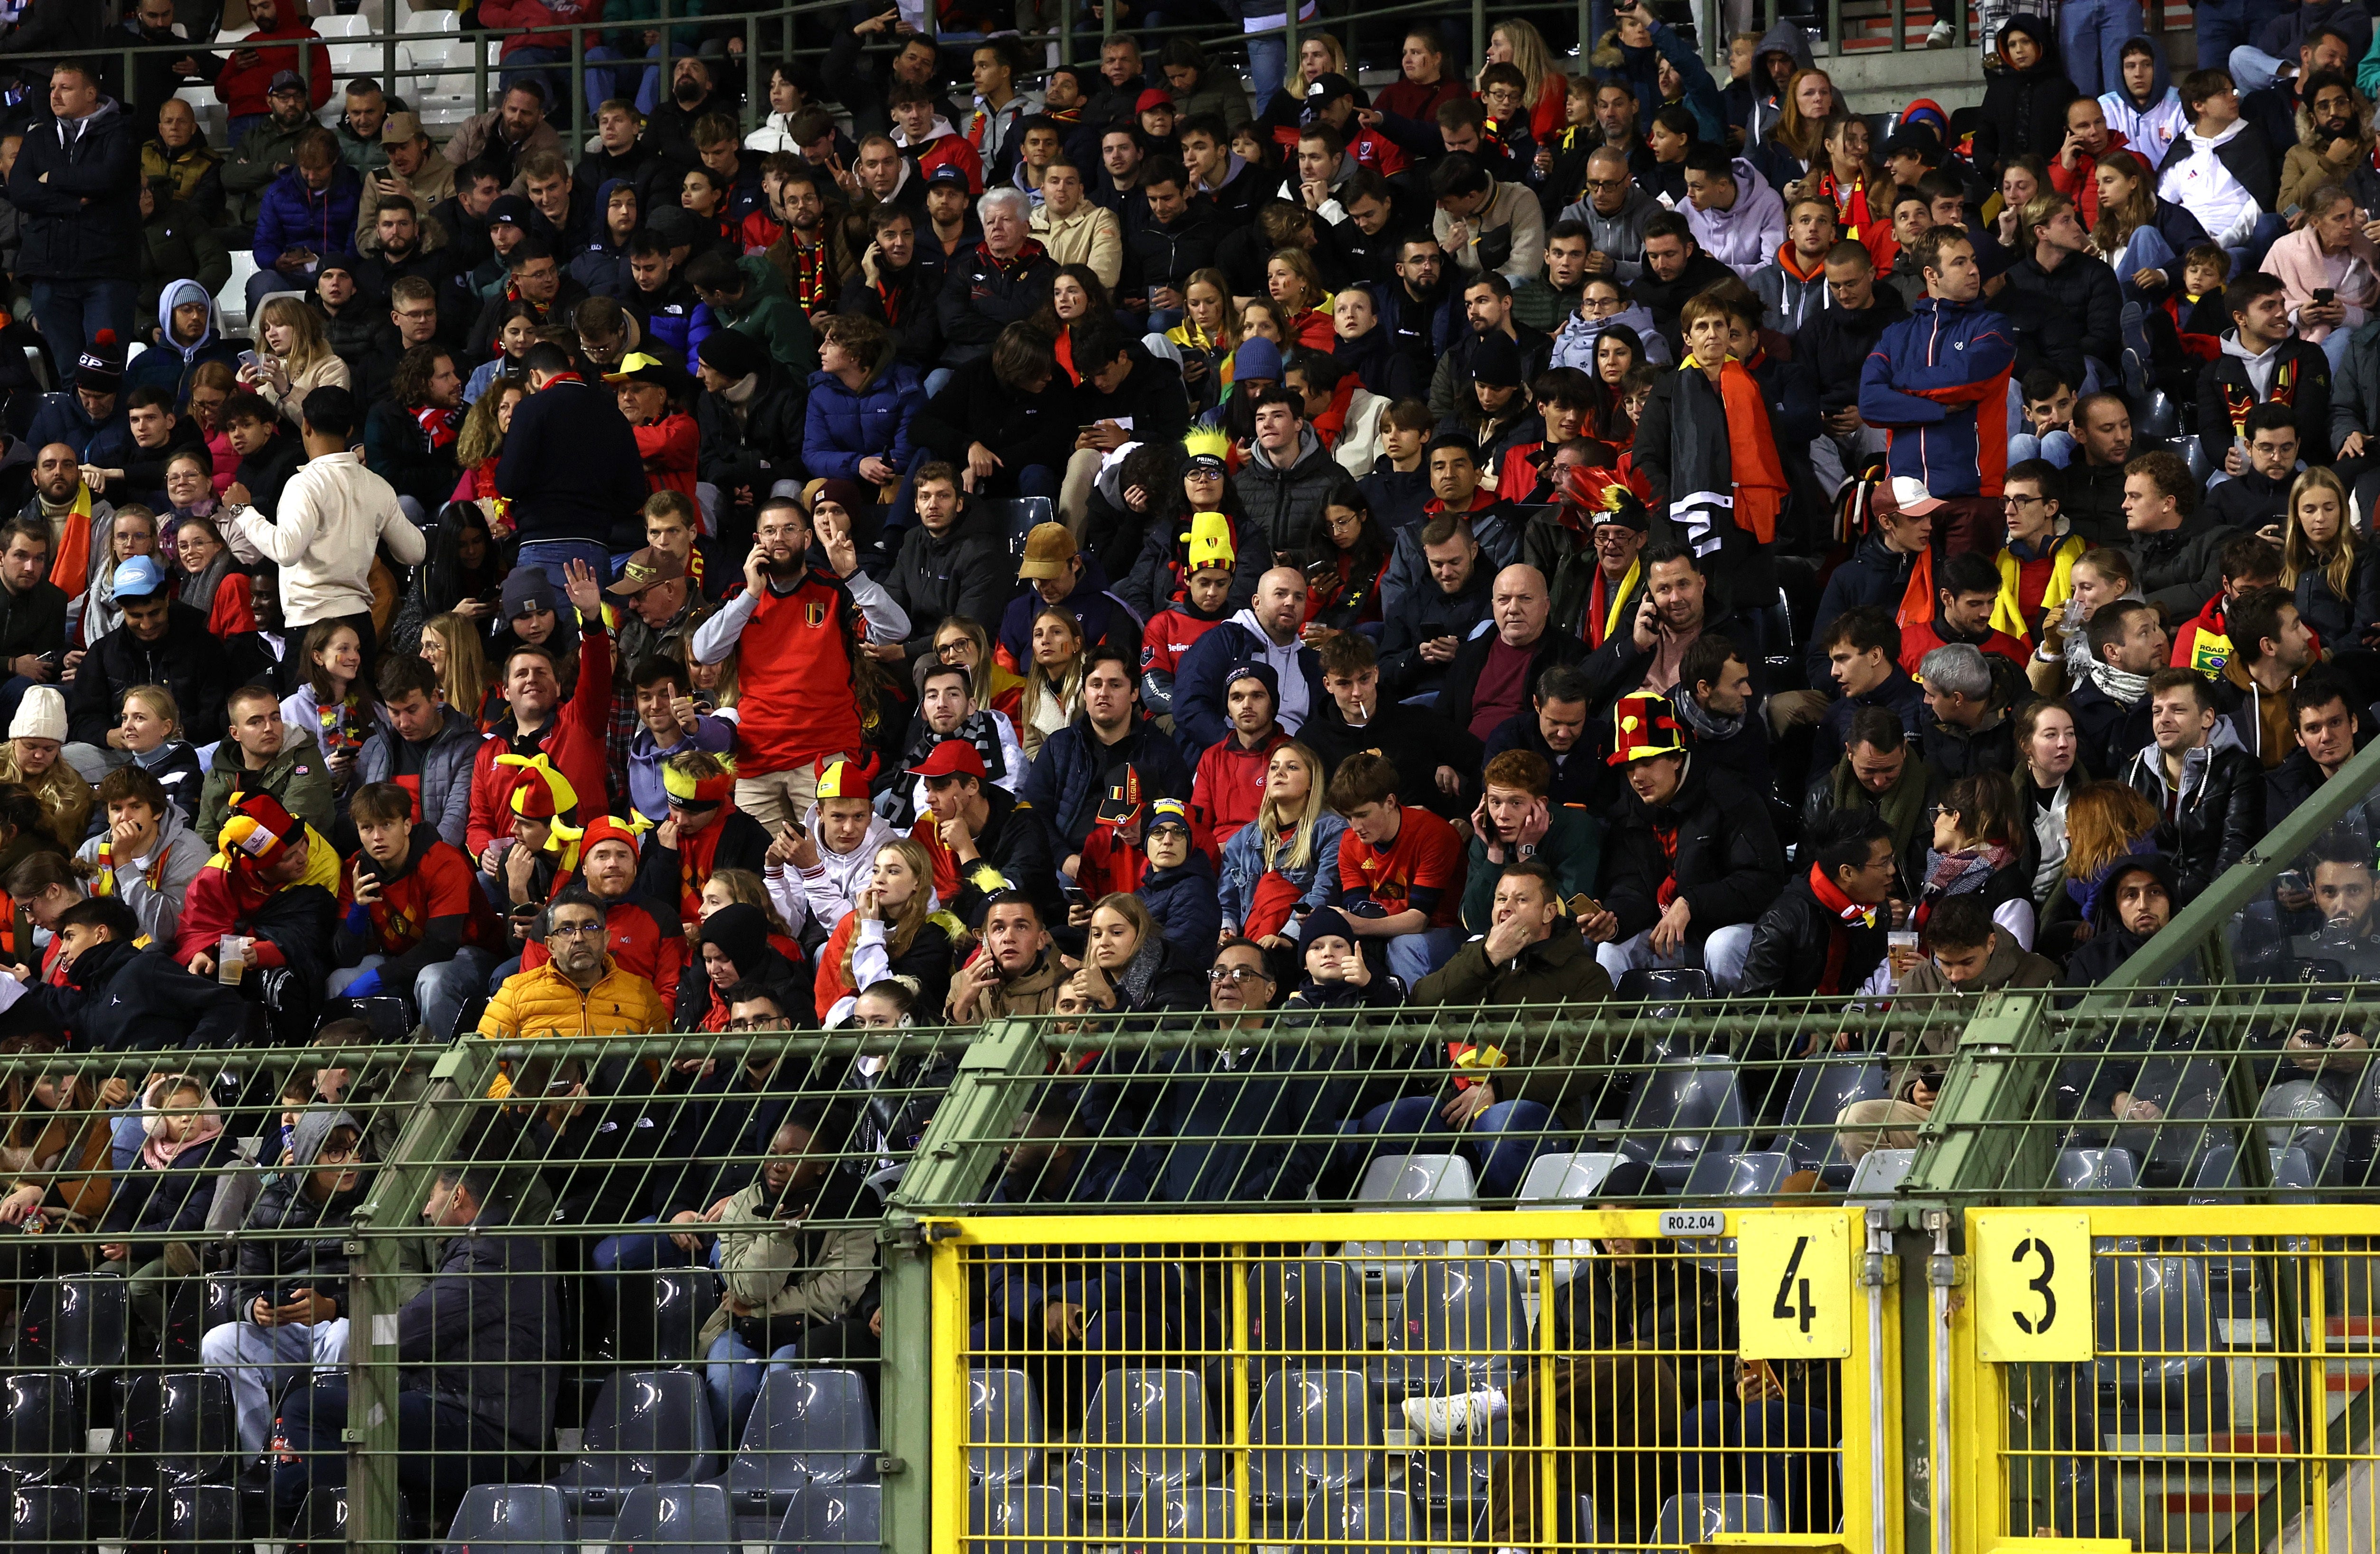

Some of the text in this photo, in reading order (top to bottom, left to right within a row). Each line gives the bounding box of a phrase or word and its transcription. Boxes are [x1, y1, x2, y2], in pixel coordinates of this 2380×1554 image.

[1196, 457, 1219, 465] PRIMUS
[2200, 645, 2225, 653] ROAD
[1773, 1236, 1816, 1333] 4
[2012, 1238, 2056, 1335] 3
